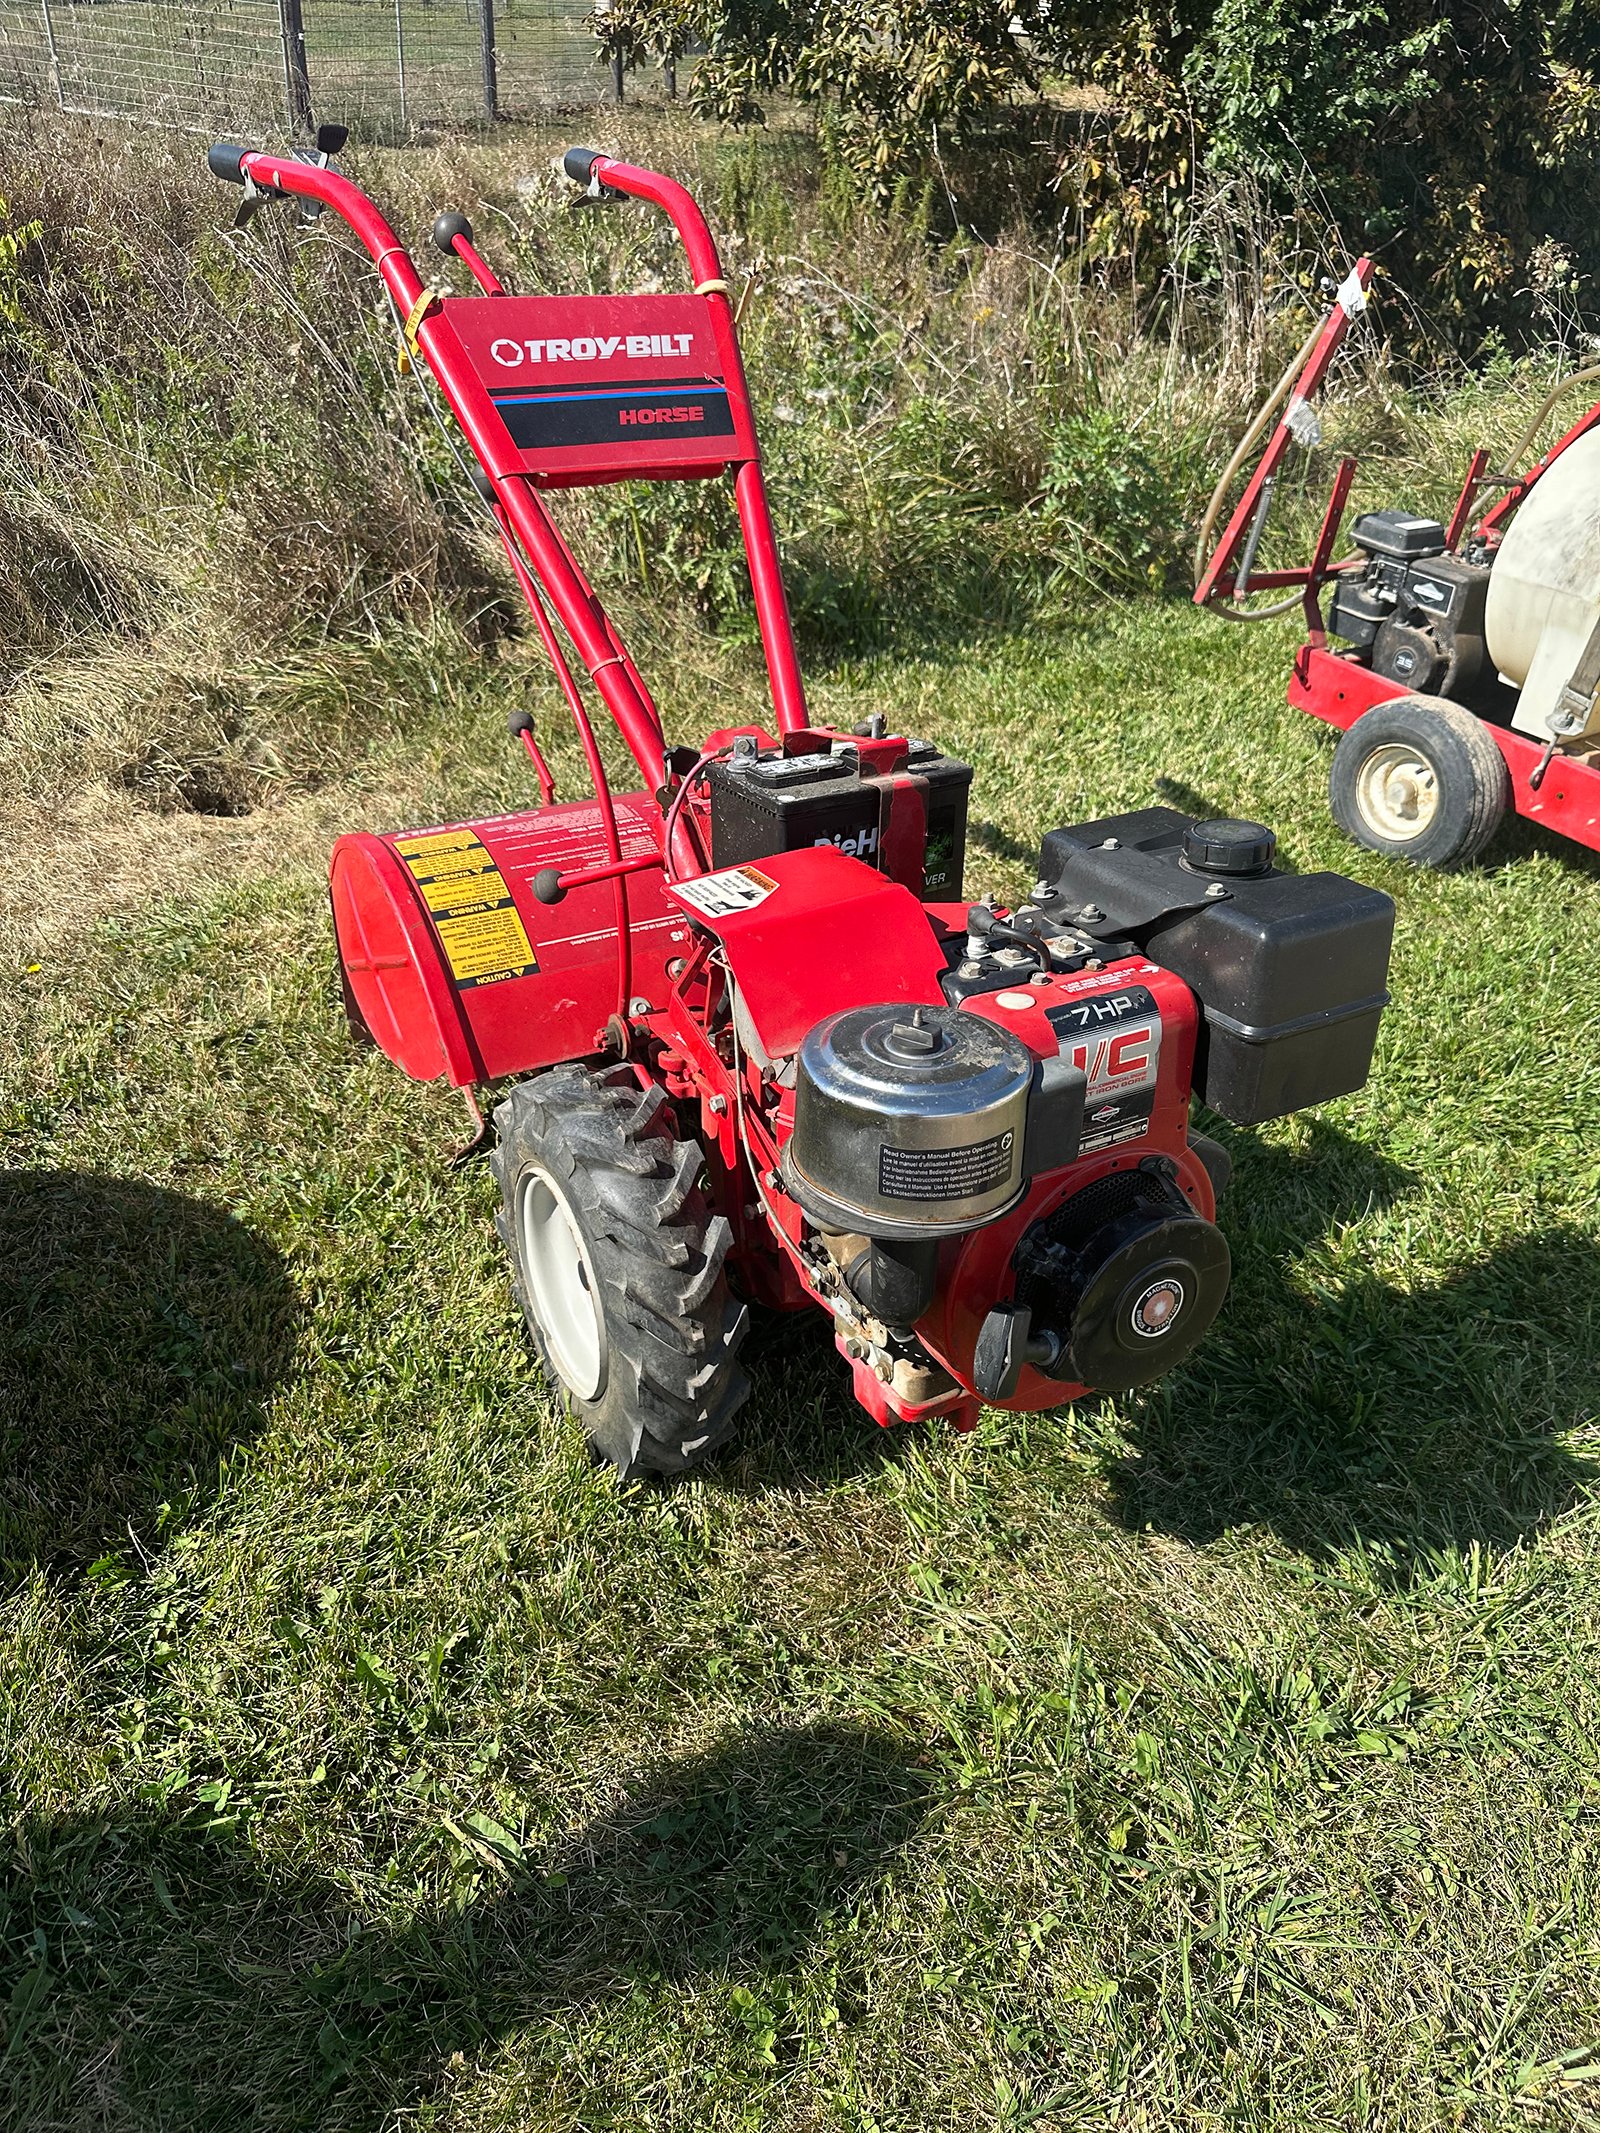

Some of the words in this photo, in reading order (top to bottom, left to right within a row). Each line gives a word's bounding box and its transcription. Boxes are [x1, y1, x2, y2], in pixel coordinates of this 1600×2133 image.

[524, 334, 694, 363] TROY-BILT
[619, 406, 704, 425] HORSE
[432, 870, 471, 881] WARNING
[925, 872, 946, 886] VER
[447, 903, 487, 916] WARNING
[475, 970, 512, 985] CAUTION
[1072, 1026, 1151, 1083] I/C
[1096, 1084, 1119, 1094] IRON
[1122, 1076, 1147, 1088] BORE
[884, 1148, 899, 1157] Read
[1146, 1283, 1178, 1298] MAGNETRON
